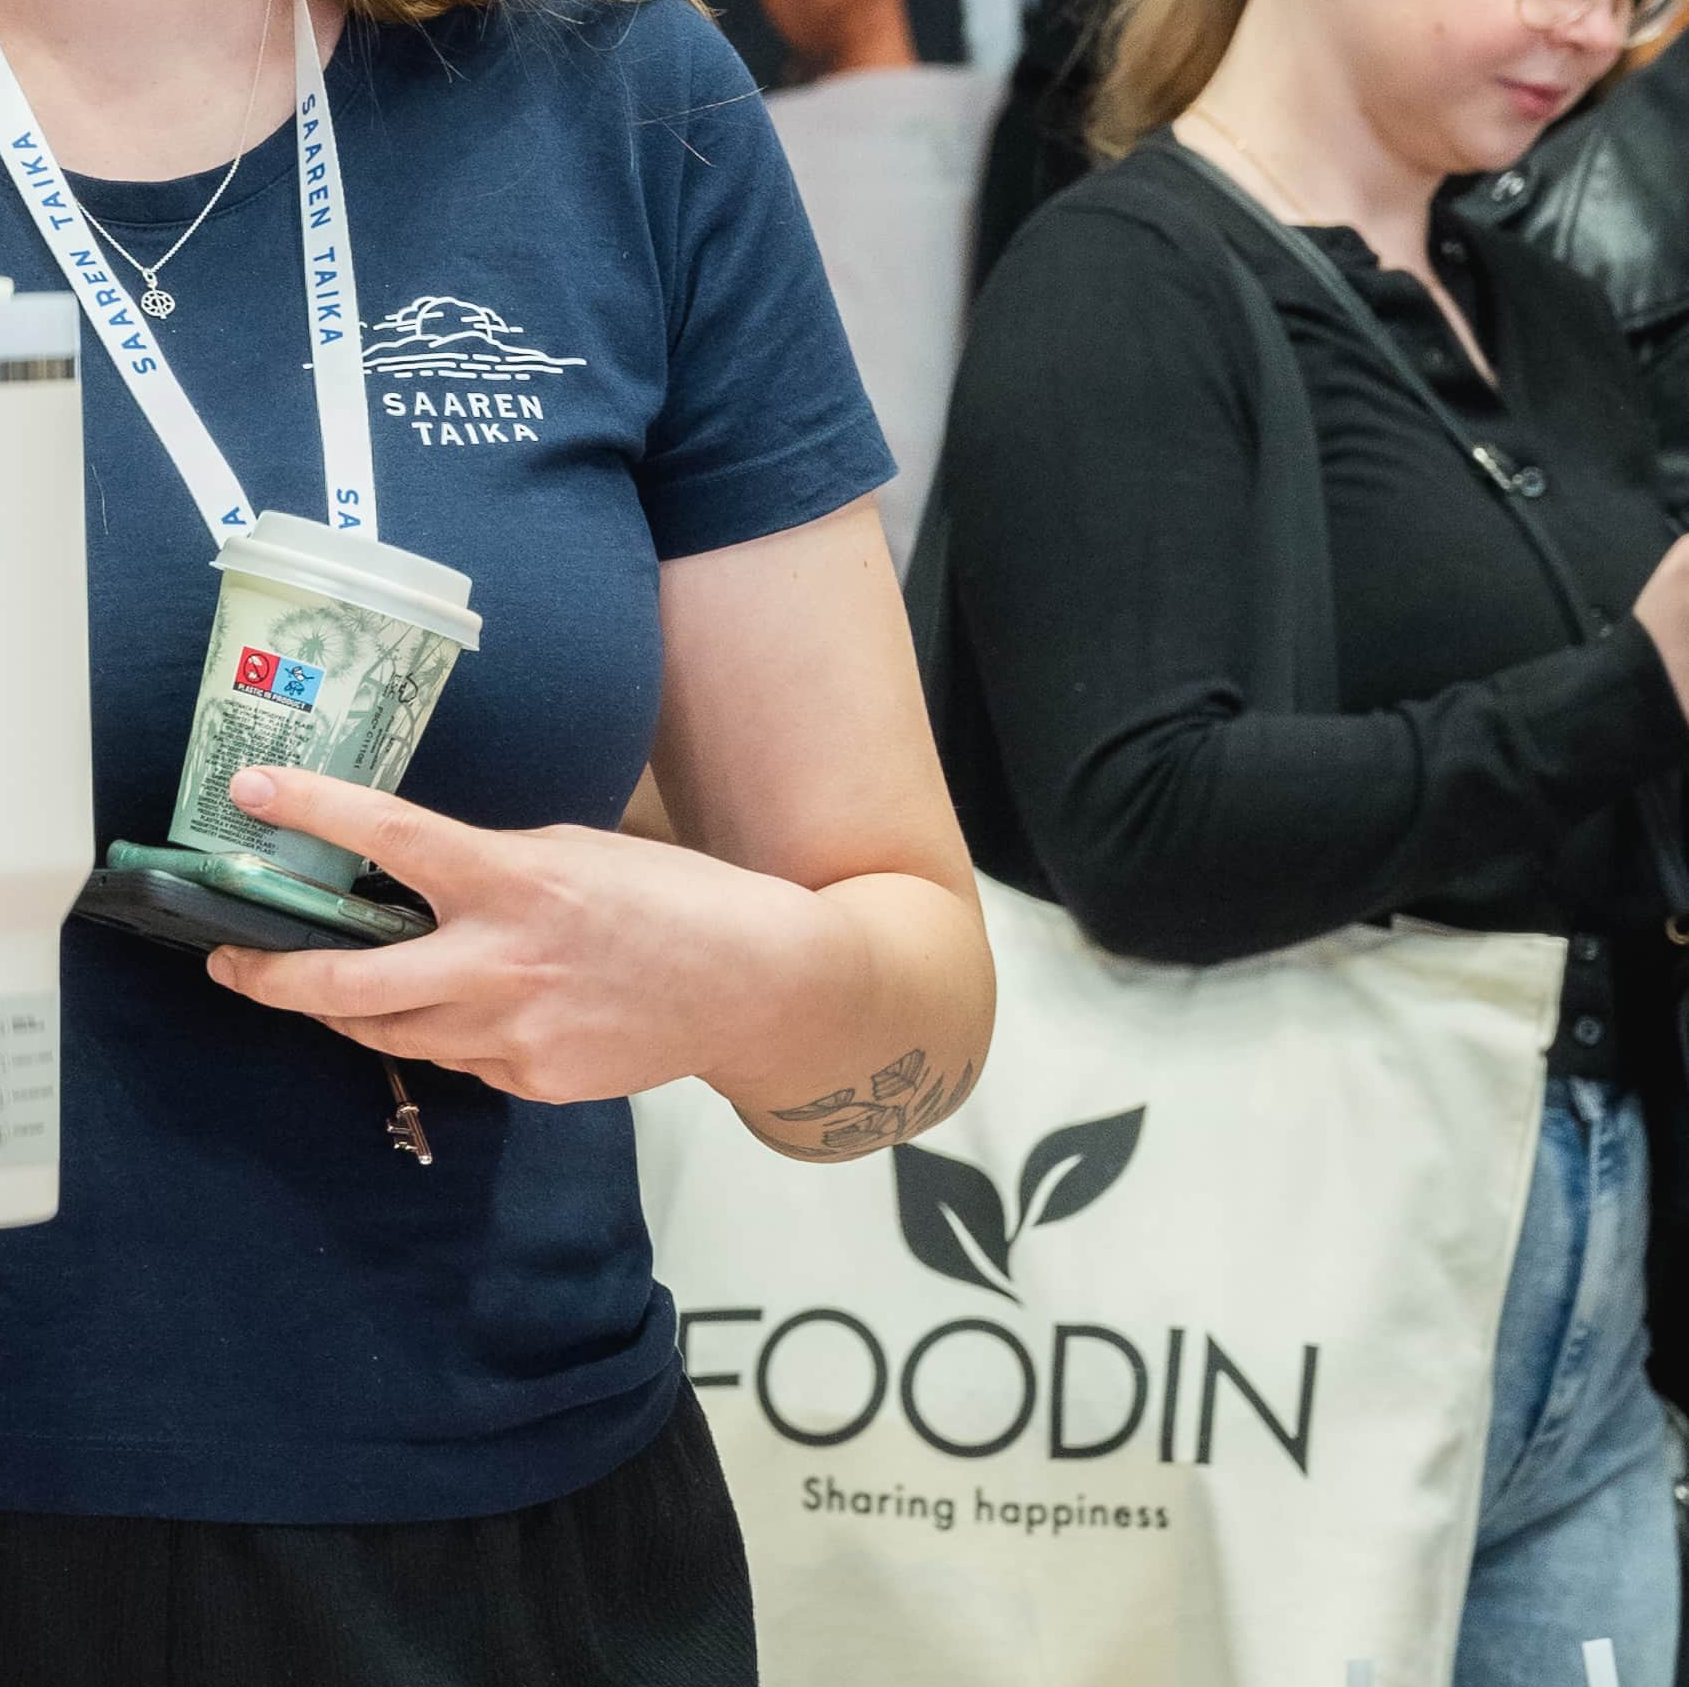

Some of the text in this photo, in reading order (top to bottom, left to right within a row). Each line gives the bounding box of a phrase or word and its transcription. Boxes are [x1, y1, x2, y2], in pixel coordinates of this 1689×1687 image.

[301, 93, 344, 346] SAAREN TAIKA
[12, 130, 157, 375] SAAREN TAIKA
[382, 391, 544, 420] SAAREN
[410, 421, 540, 446] TAIKA
[236, 682, 264, 698] PLASTIC
[271, 692, 306, 710] PRODUCT
[678, 1306, 1320, 1478] FOODIN
[801, 1476, 1171, 1536] Sharing happiness
